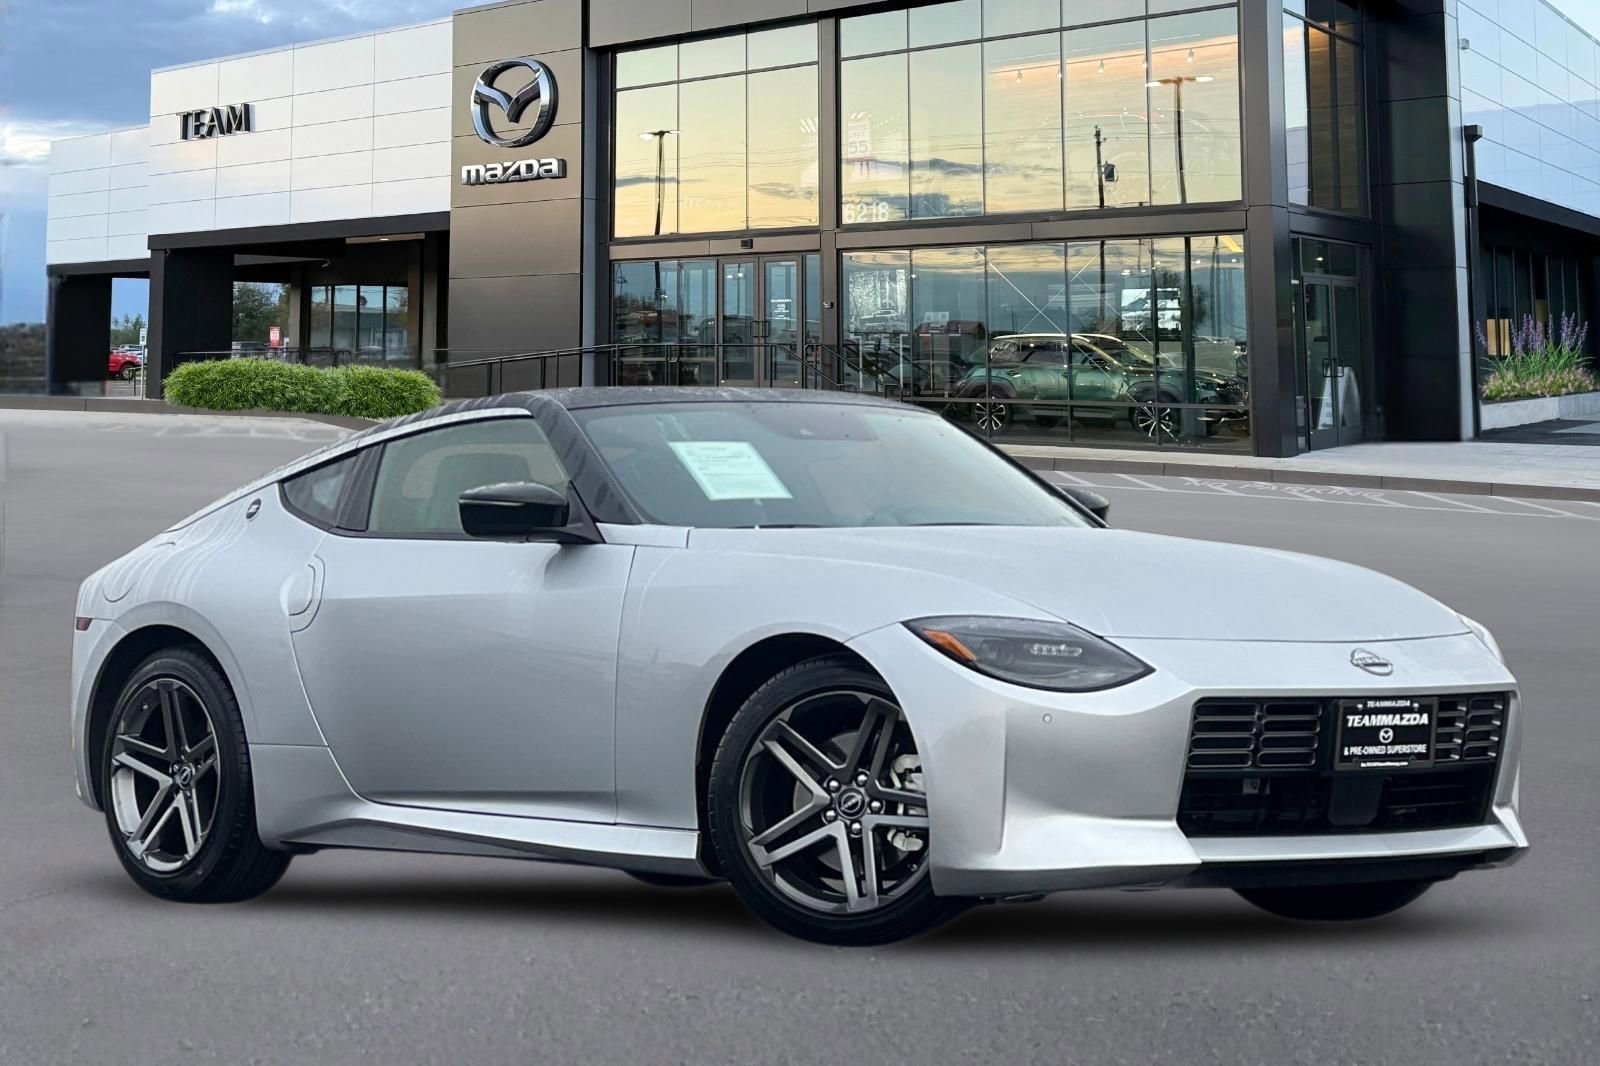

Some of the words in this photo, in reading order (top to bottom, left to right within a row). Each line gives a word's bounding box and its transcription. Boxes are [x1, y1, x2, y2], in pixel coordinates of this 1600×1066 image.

[176, 103, 250, 140] TEAM
[844, 201, 889, 223] 6218
[1350, 745, 1386, 755] PRE-OWNED
[1386, 744, 1427, 754] SUPERSTORE
